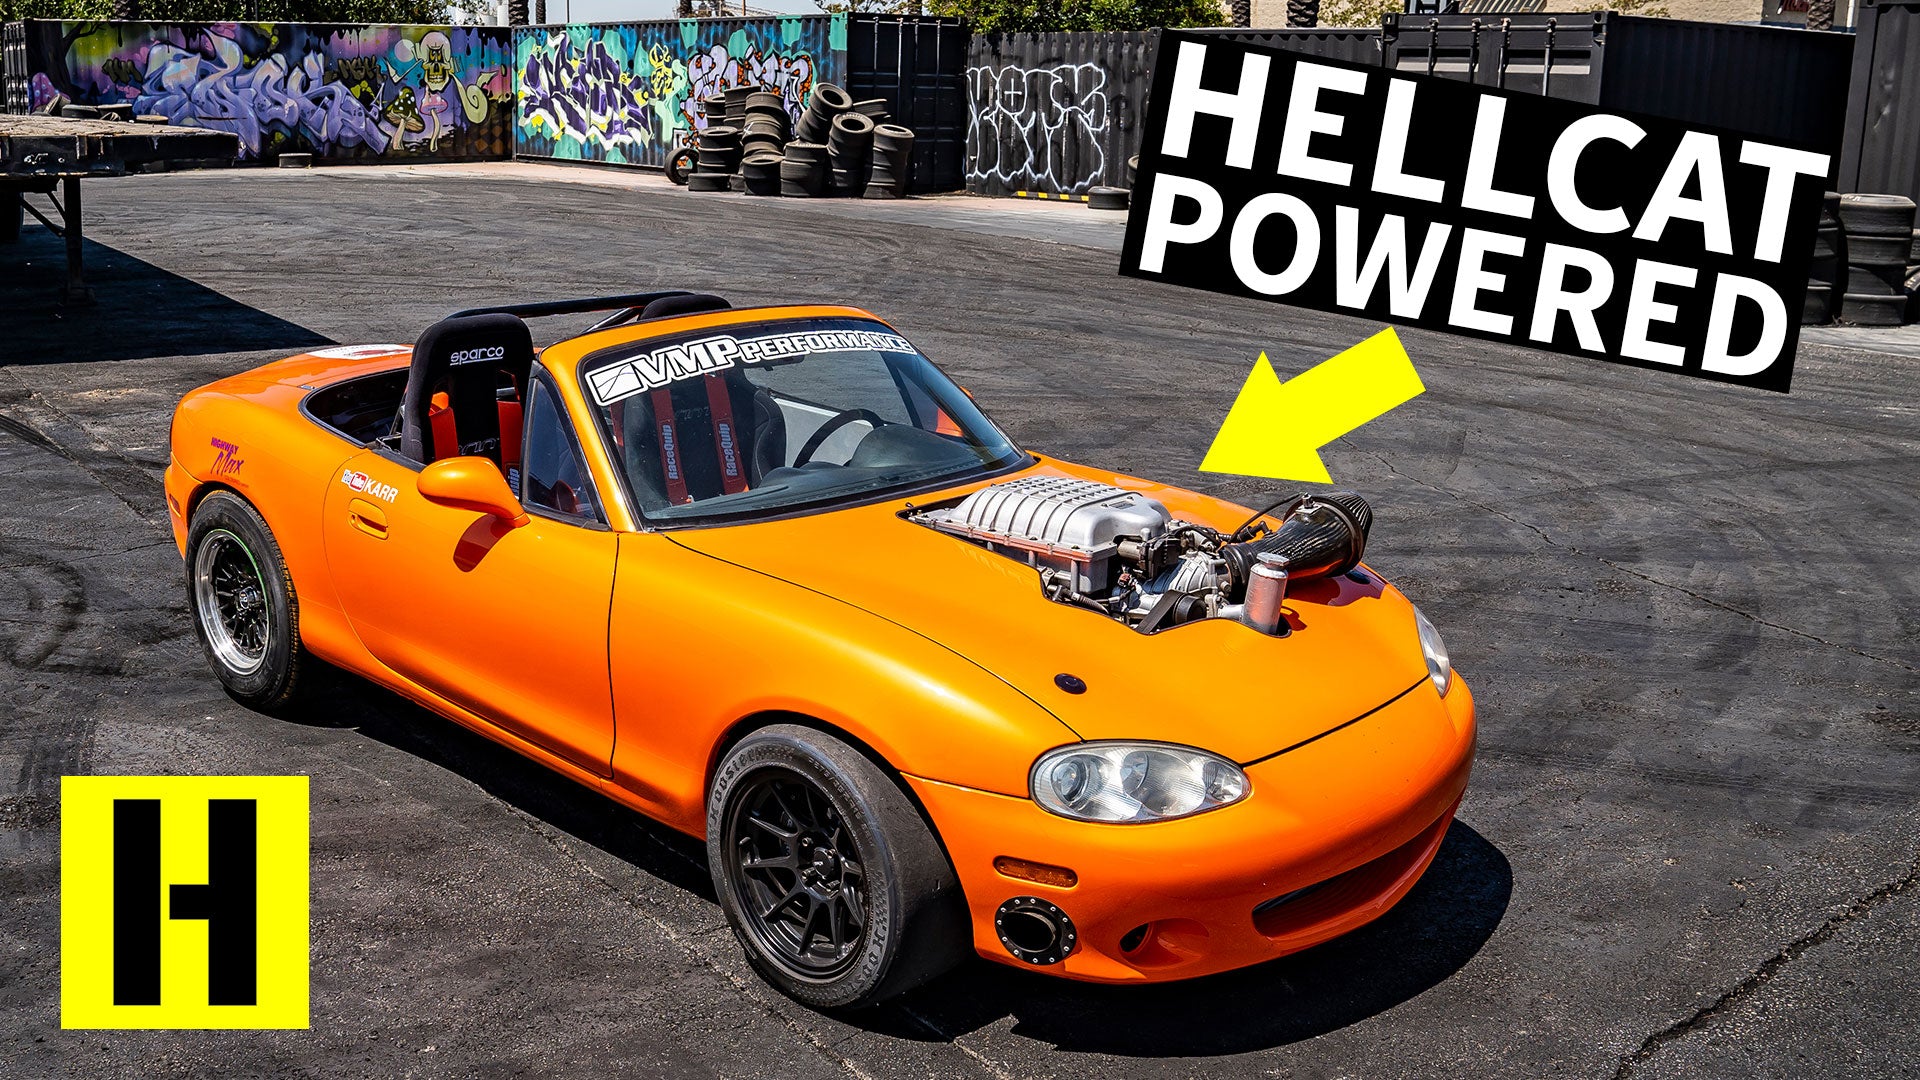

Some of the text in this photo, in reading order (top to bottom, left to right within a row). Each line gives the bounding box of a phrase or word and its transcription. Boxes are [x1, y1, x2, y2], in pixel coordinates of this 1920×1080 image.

[450, 346, 504, 365] sparco
[630, 332, 912, 385] VMP PERFORMANCE
[211, 436, 239, 455] HIGHWAY
[662, 424, 679, 480] RaceQuip
[719, 423, 738, 477] RaceQuip
[210, 449, 245, 477] Max
[363, 478, 399, 504] KARR
